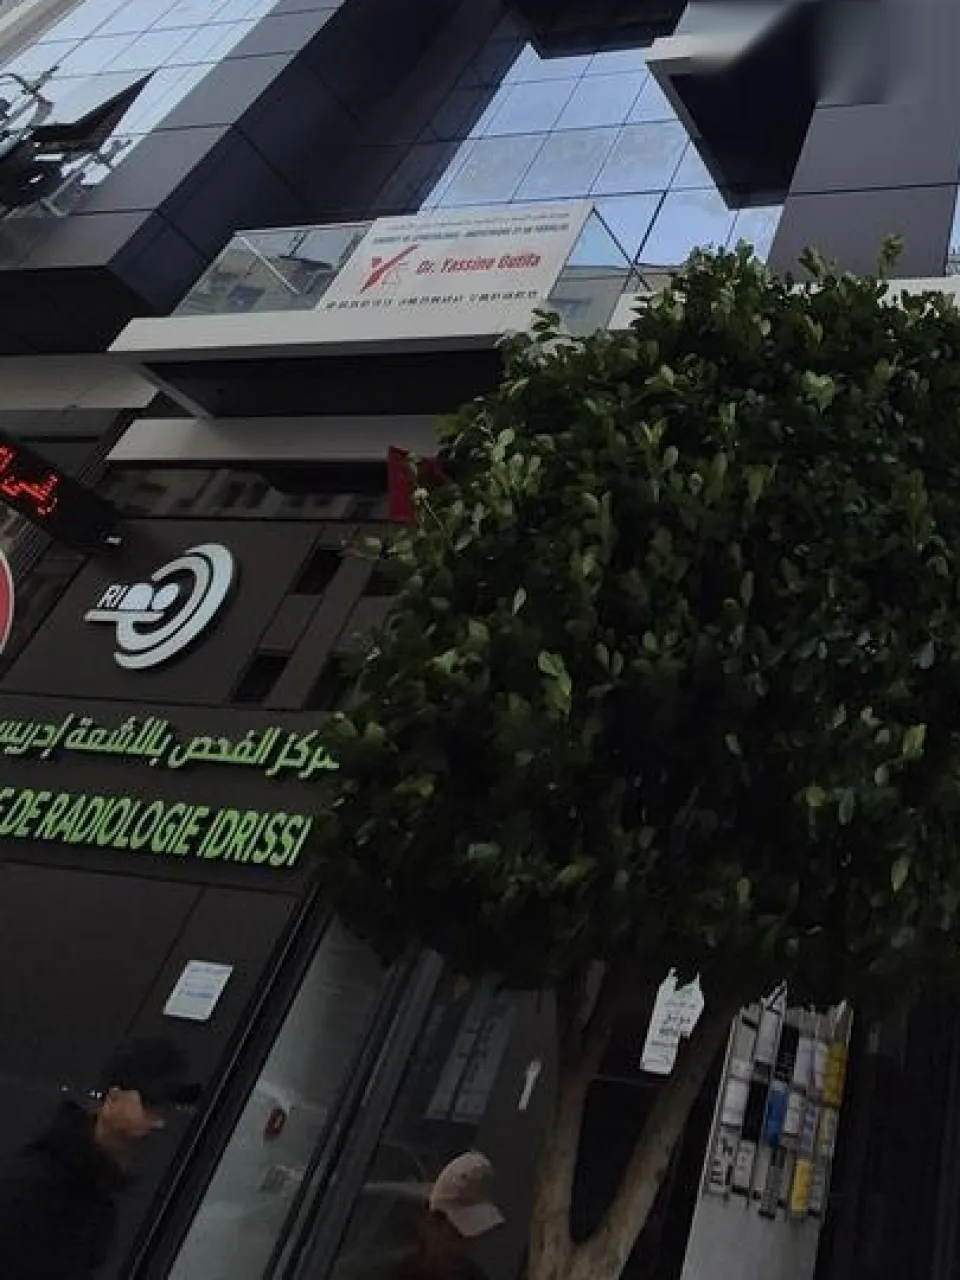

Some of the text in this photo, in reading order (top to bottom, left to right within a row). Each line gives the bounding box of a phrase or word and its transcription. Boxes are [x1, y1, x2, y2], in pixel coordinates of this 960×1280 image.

[167, 727, 283, 768] الفحص
[0, 788, 53, 838] DE
[33, 793, 210, 856] RADIOLOGIE
[196, 807, 314, 866] IDRISSI
